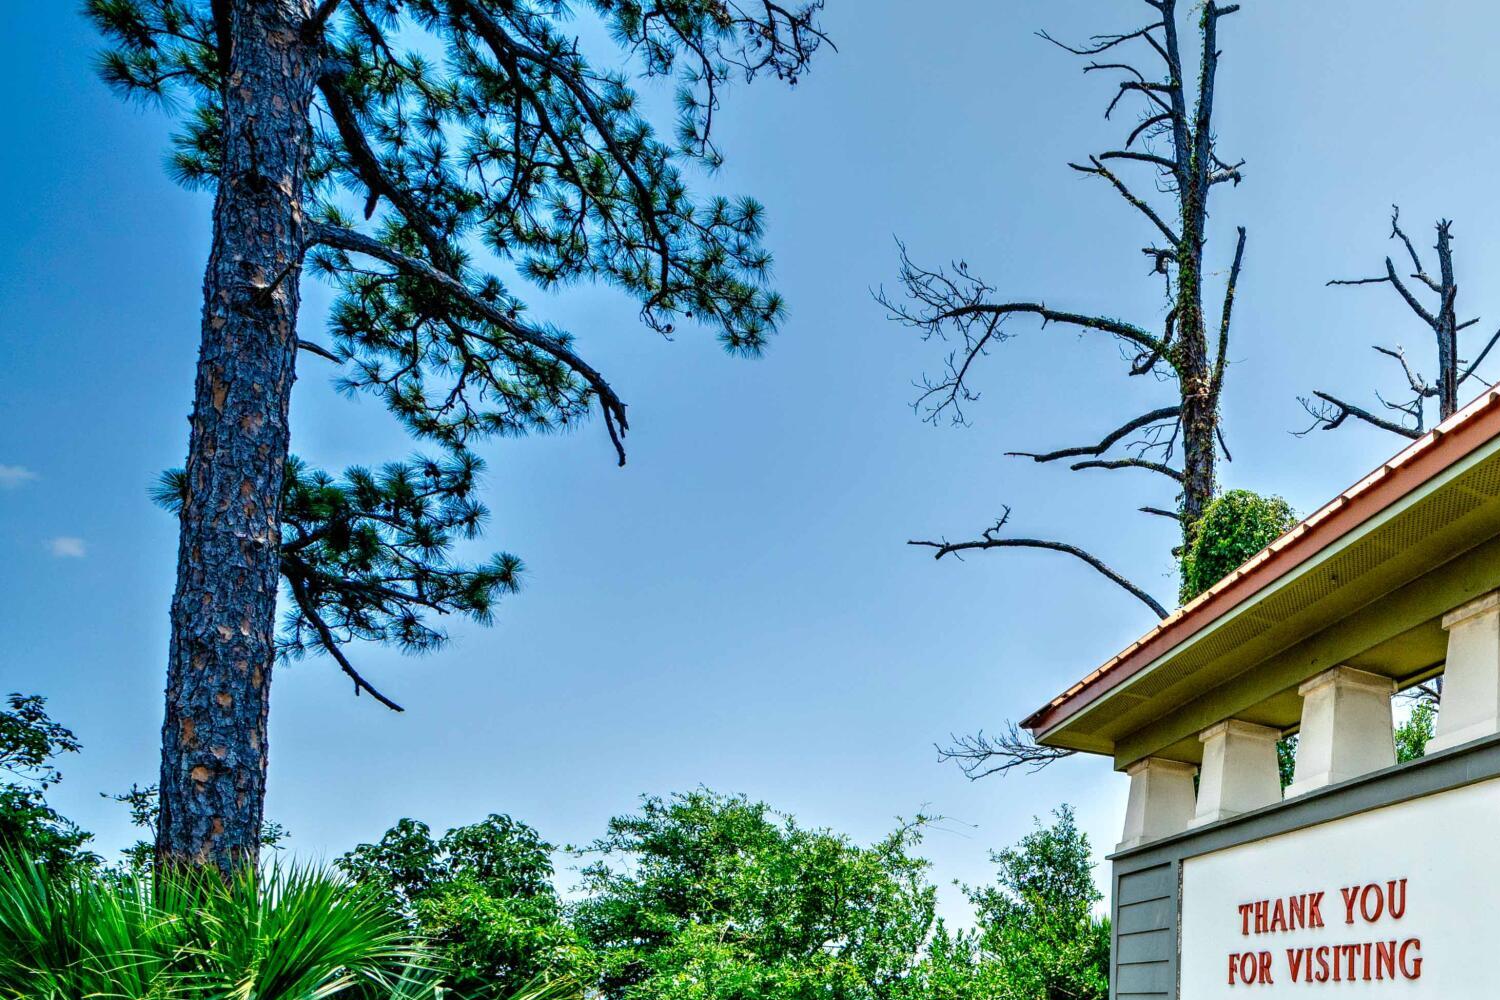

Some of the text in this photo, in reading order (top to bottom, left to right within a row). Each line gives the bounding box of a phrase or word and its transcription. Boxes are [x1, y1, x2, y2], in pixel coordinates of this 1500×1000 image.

[1238, 878, 1408, 935] THANK YOU
[1228, 938, 1422, 985] FOR VISITING
